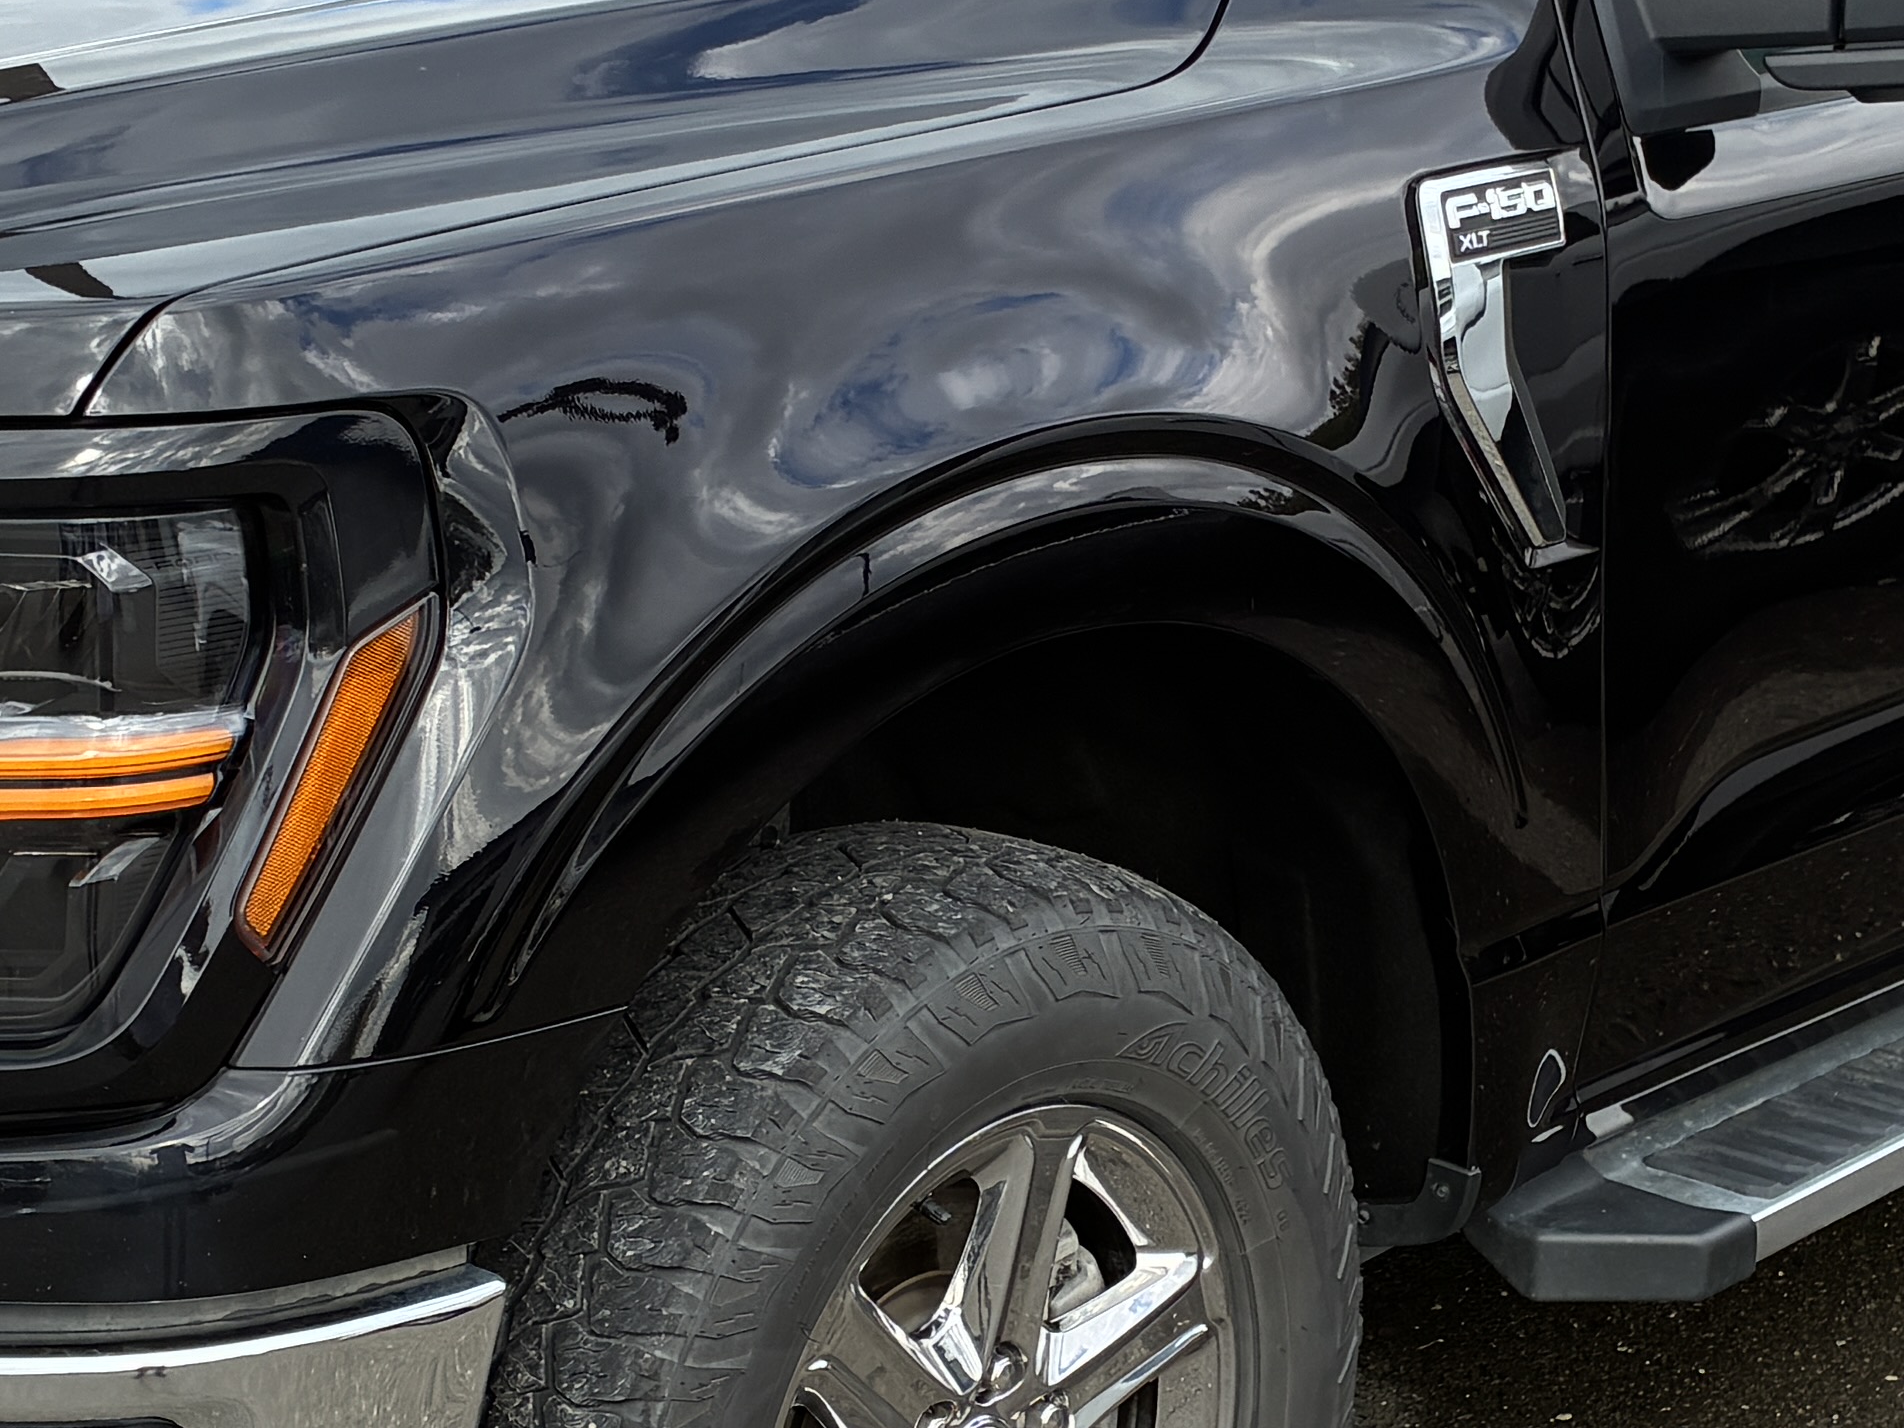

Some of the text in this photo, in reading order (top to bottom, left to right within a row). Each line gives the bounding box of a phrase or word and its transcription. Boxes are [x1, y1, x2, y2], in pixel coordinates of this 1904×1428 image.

[1445, 179, 1557, 230] F-150
[1458, 229, 1491, 253] XLT
[1115, 1021, 1294, 1190] Achilles
